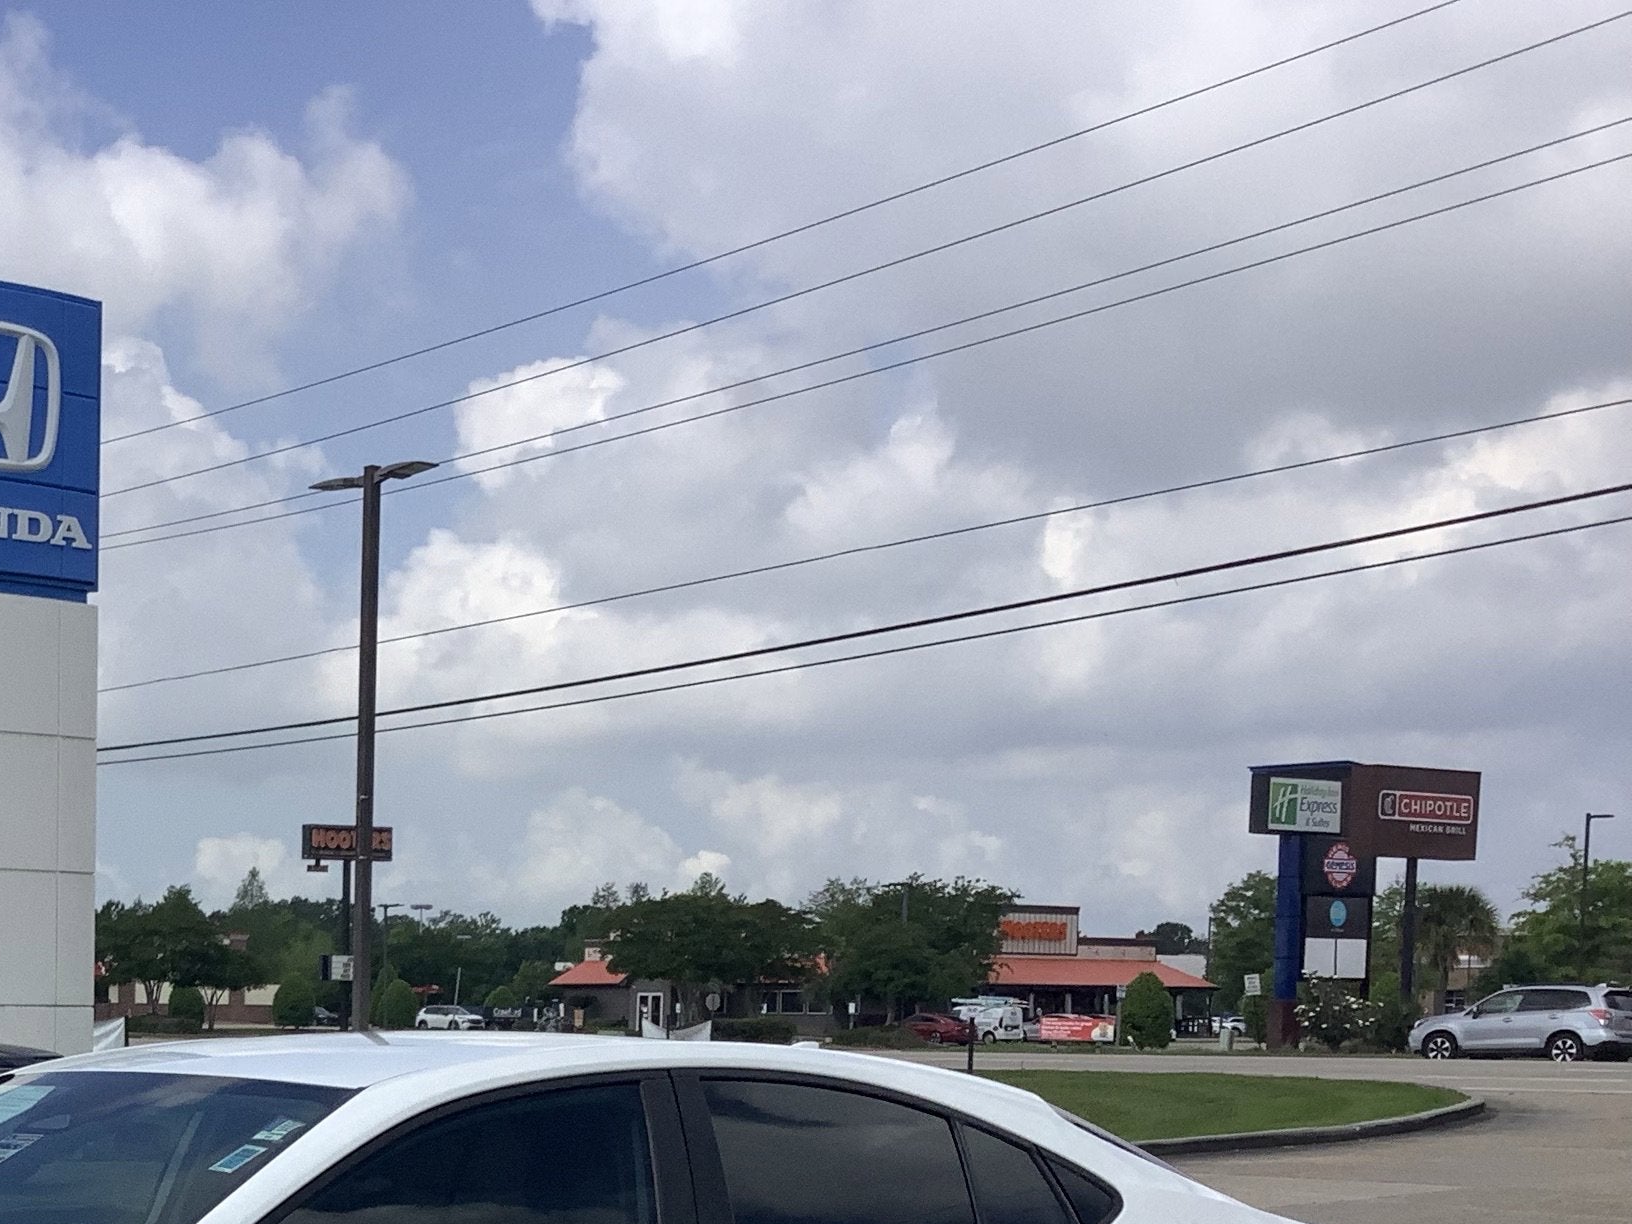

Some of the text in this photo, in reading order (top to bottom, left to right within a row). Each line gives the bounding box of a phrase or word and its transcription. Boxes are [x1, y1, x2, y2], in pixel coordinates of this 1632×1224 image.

[1300, 797, 1338, 816] Express
[1401, 799, 1469, 817] CHIPOTLE
[1409, 823, 1466, 835] MEXICAN GRILL
[311, 828, 391, 850] HOOTRS
